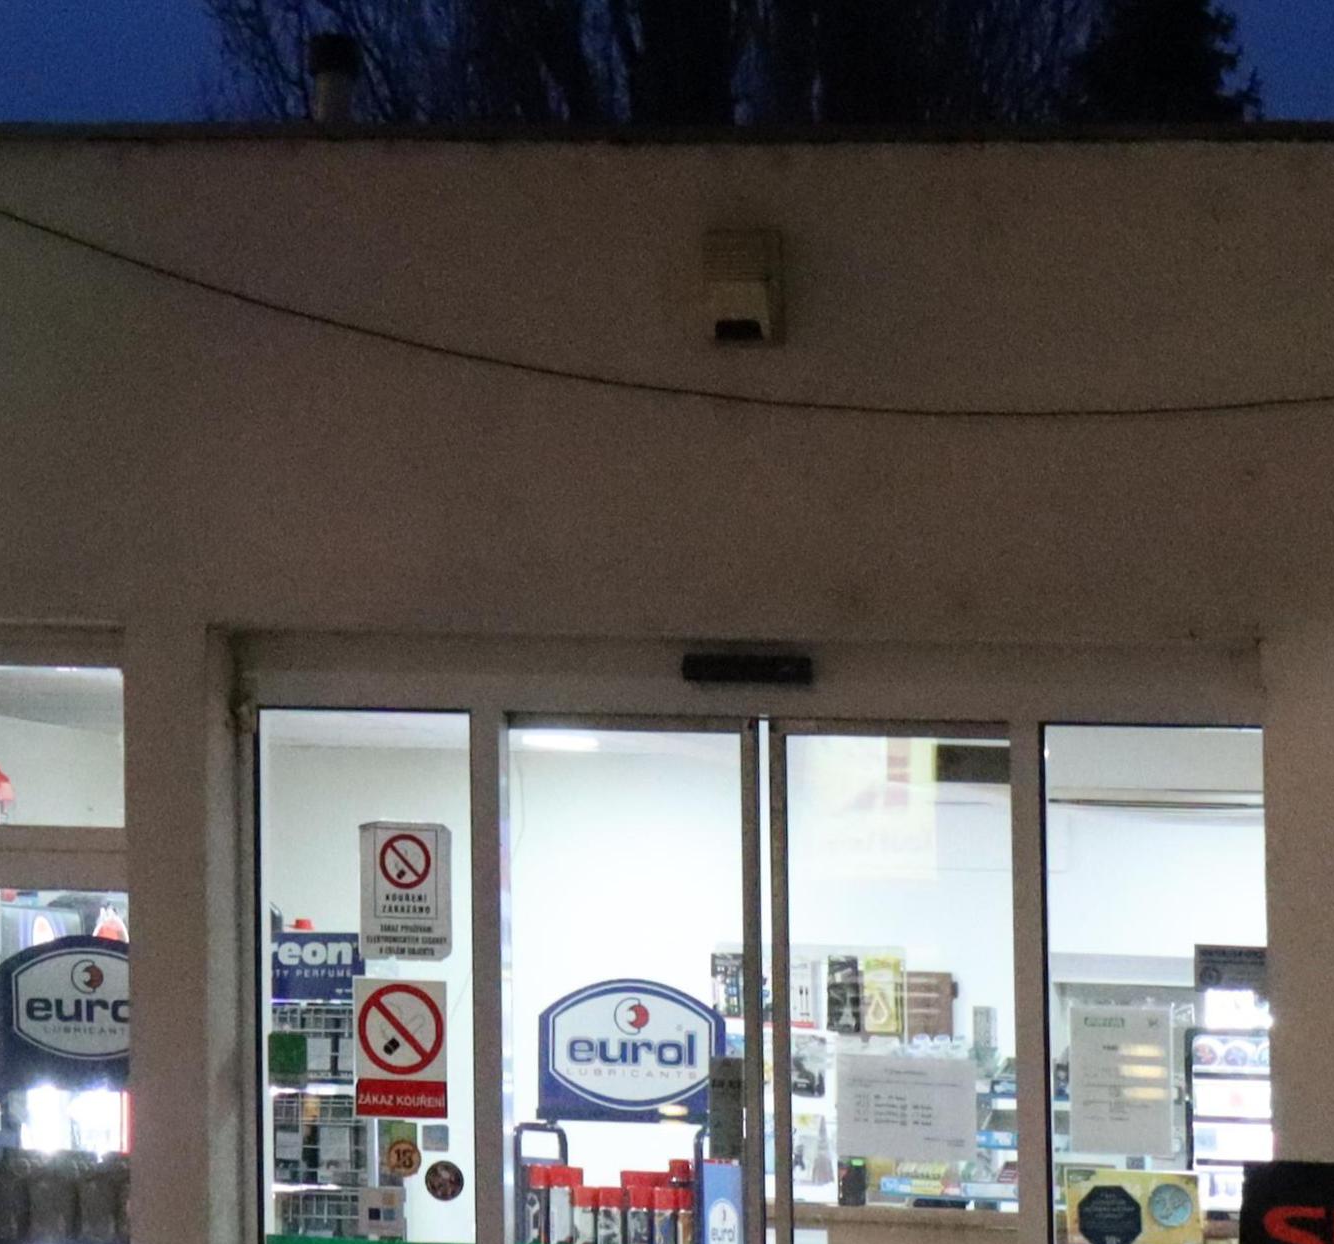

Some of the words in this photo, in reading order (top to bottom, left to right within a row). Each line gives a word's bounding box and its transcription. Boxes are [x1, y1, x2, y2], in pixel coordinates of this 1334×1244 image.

[567, 1031, 698, 1069] eurol
[358, 1093, 395, 1106] ZÁKAZ
[396, 1095, 446, 1109] KOUŘENÍ
